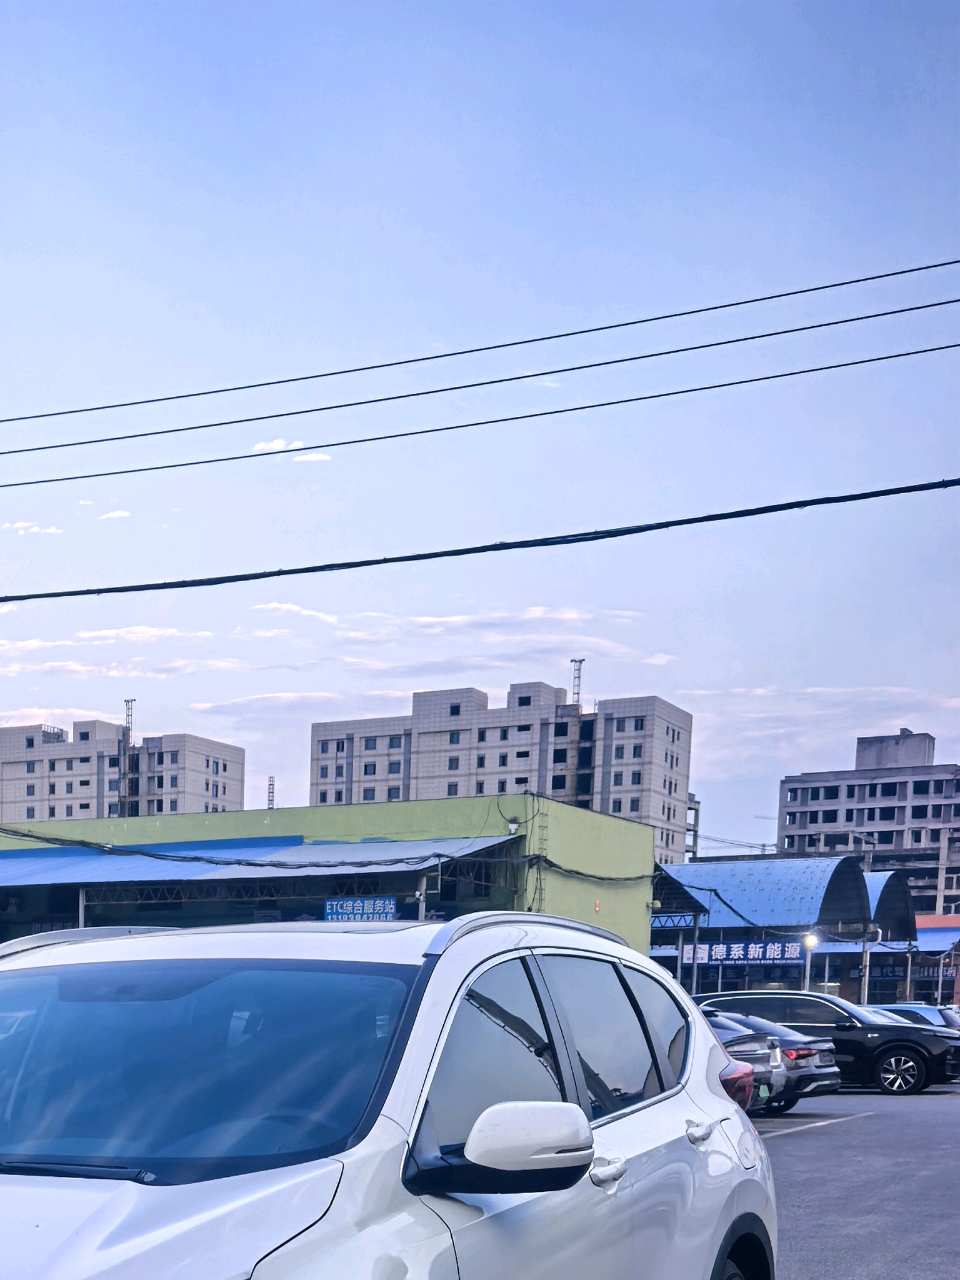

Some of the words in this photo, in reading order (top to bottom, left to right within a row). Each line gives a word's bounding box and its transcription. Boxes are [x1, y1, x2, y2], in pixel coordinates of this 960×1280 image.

[326, 899, 396, 914] ETC综合服务站
[711, 942, 801, 960] 德系新能源
